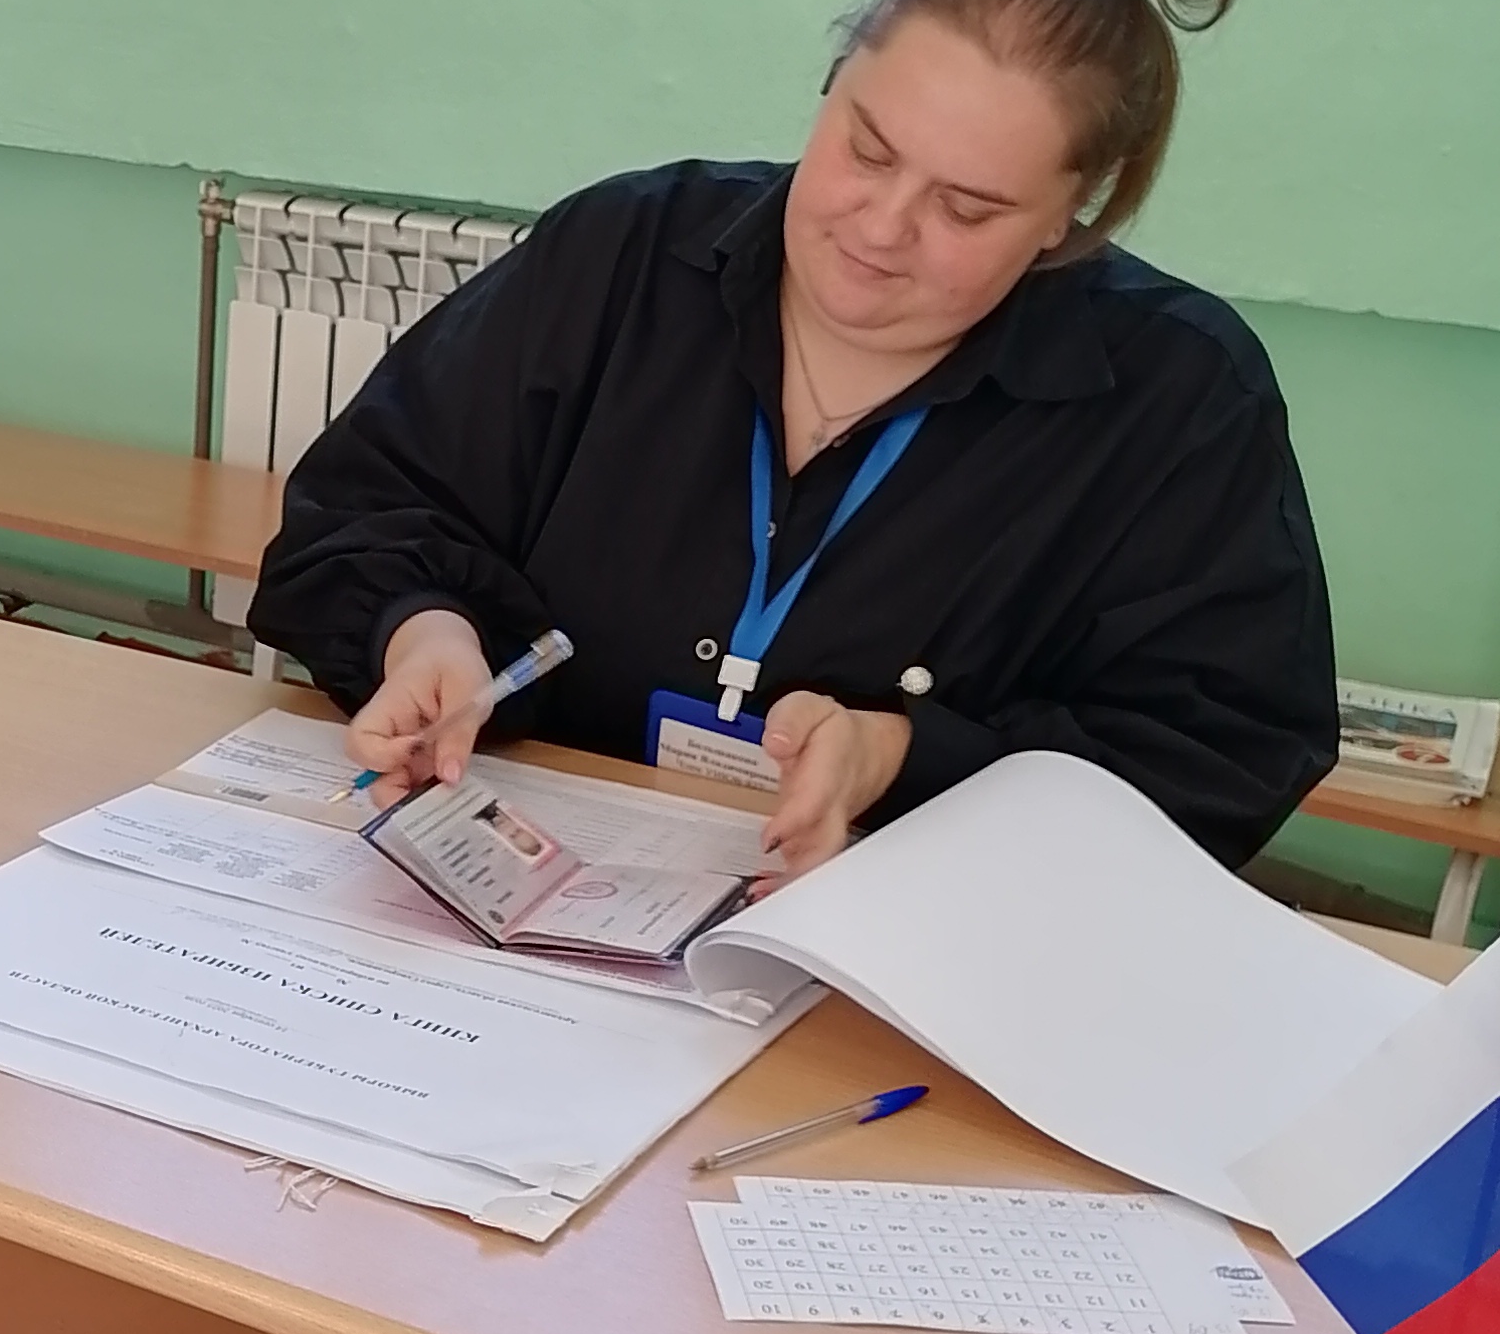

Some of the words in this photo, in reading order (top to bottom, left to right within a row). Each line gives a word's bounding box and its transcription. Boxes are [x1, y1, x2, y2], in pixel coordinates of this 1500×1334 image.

[99, 927, 272, 981] ИЗБИРАТЕЛЕЙ
[8, 971, 82, 995] ОБЛАСТИ
[280, 978, 382, 1015] СПИСКА
[84, 993, 224, 1037] АРХАНГЕЛЬСКОЙ
[392, 1012, 480, 1043] КНИГА
[230, 1035, 348, 1077] ГУБЕРНАТОРА
[351, 1074, 430, 1099] ВЫБОРЫ
[744, 1258, 764, 1268] 30
[785, 1259, 806, 1269] 29
[826, 1261, 846, 1271] 28
[868, 1263, 888, 1274] 27
[907, 1264, 928, 1274] 26
[949, 1265, 970, 1276] 25
[990, 1267, 1012, 1278] 24
[1032, 1269, 1054, 1280] 23
[1072, 1270, 1094, 1282] 22
[1115, 1272, 1136, 1284] 21
[752, 1279, 774, 1290] 20
[794, 1281, 814, 1291] 19
[835, 1283, 855, 1293] 18
[878, 1285, 898, 1296] 17
[917, 1287, 938, 1297] 16
[960, 1289, 980, 1299] 15
[1002, 1291, 1022, 1302] 14
[1044, 1293, 1064, 1305] 13
[1085, 1295, 1106, 1307] 12
[1129, 1297, 1147, 1309] 11
[761, 1303, 782, 1315] 10
[808, 1306, 820, 1316] 9
[850, 1306, 862, 1317] 8
